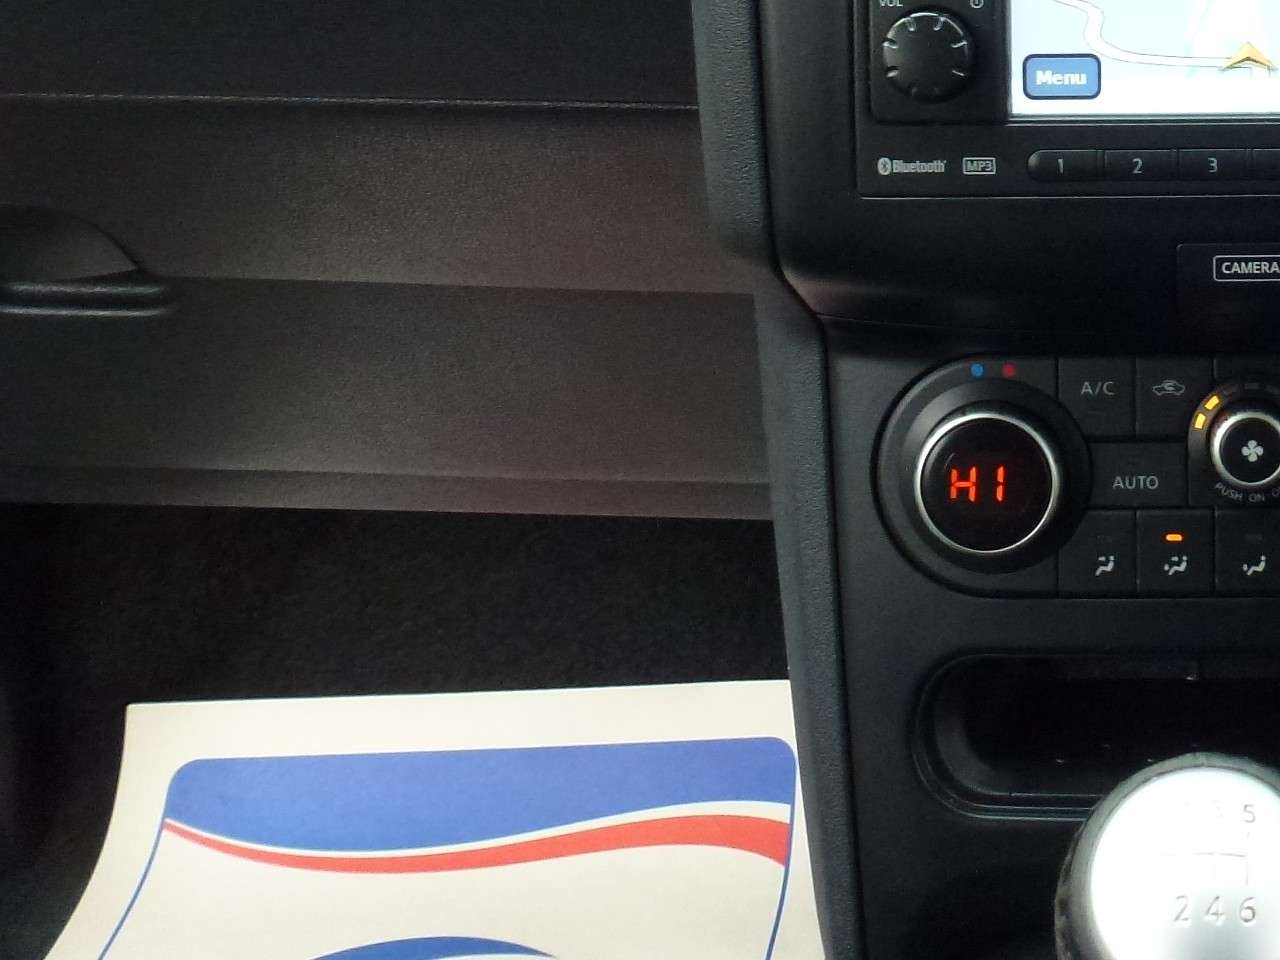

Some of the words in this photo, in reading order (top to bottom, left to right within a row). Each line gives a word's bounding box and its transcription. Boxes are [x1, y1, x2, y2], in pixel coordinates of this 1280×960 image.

[1035, 69, 1088, 86] Menu
[892, 159, 946, 173] Bluetooth
[966, 160, 993, 171] MP3
[1057, 159, 1064, 174] 1
[1132, 158, 1143, 174] 2
[1207, 158, 1218, 173] 3
[1221, 261, 1280, 274] CAMERA
[1080, 381, 1115, 396] A/C
[1112, 475, 1159, 490] AUTO
[1242, 803, 1257, 824] 5
[1173, 894, 1191, 923] 2
[1204, 893, 1225, 924] 4
[1238, 895, 1257, 924] 6
